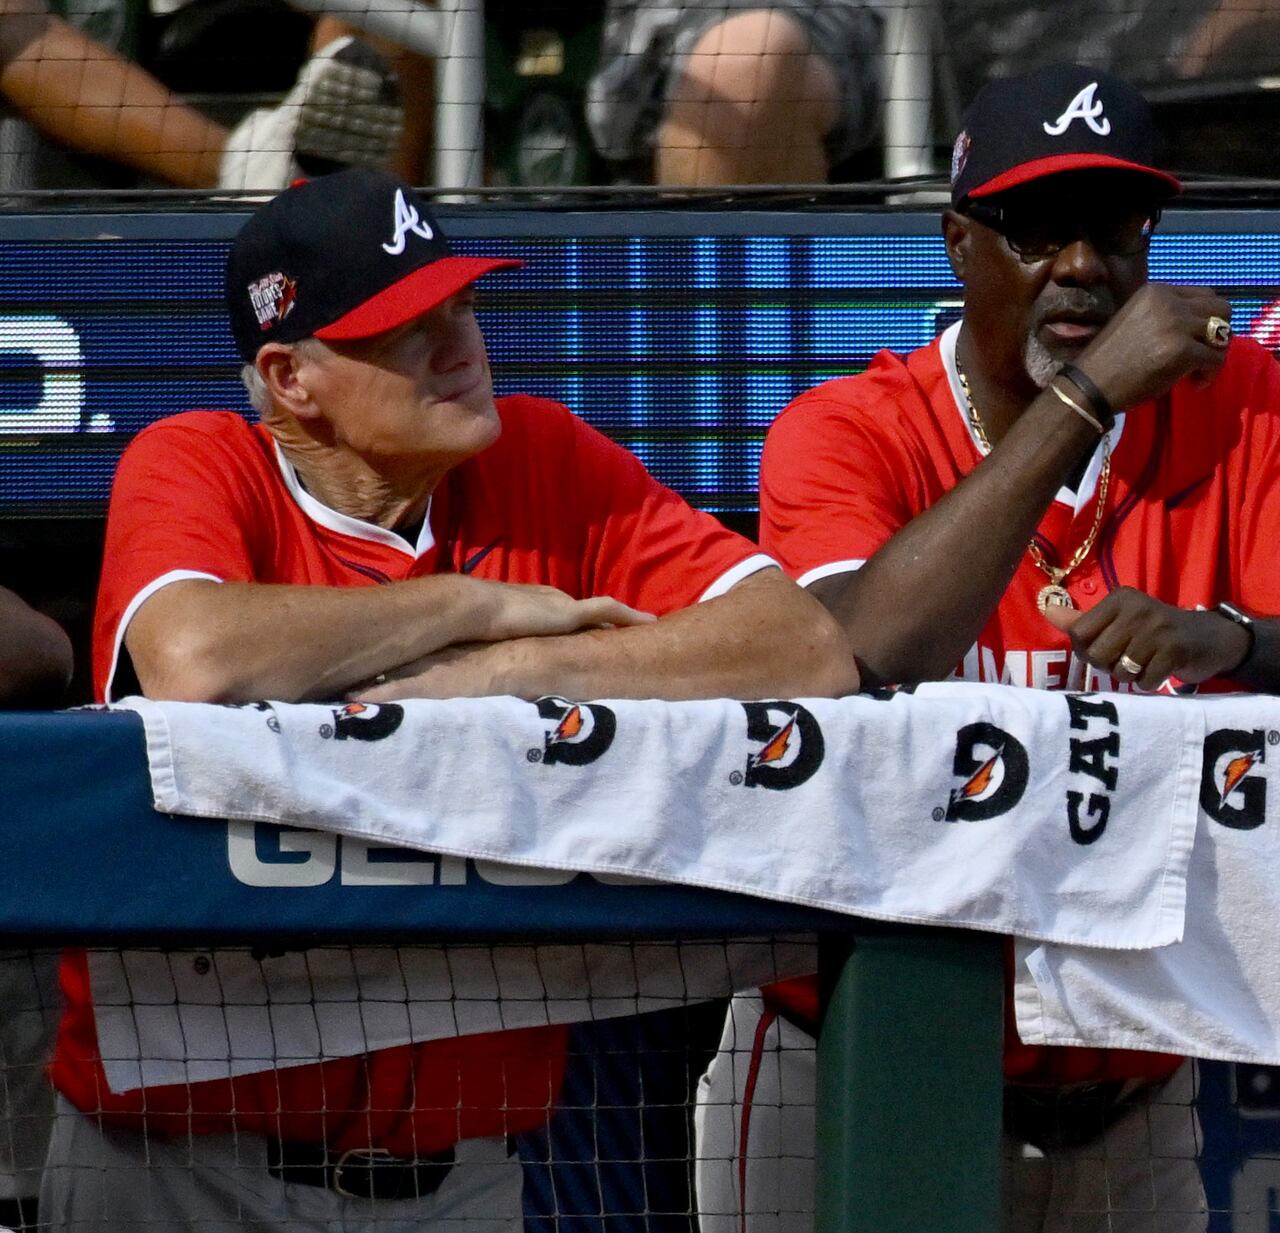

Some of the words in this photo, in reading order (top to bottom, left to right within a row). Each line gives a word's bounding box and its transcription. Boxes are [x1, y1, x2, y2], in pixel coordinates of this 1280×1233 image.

[1043, 82, 1111, 136] A
[382, 187, 433, 255] A
[1200, 728, 1266, 829] G
